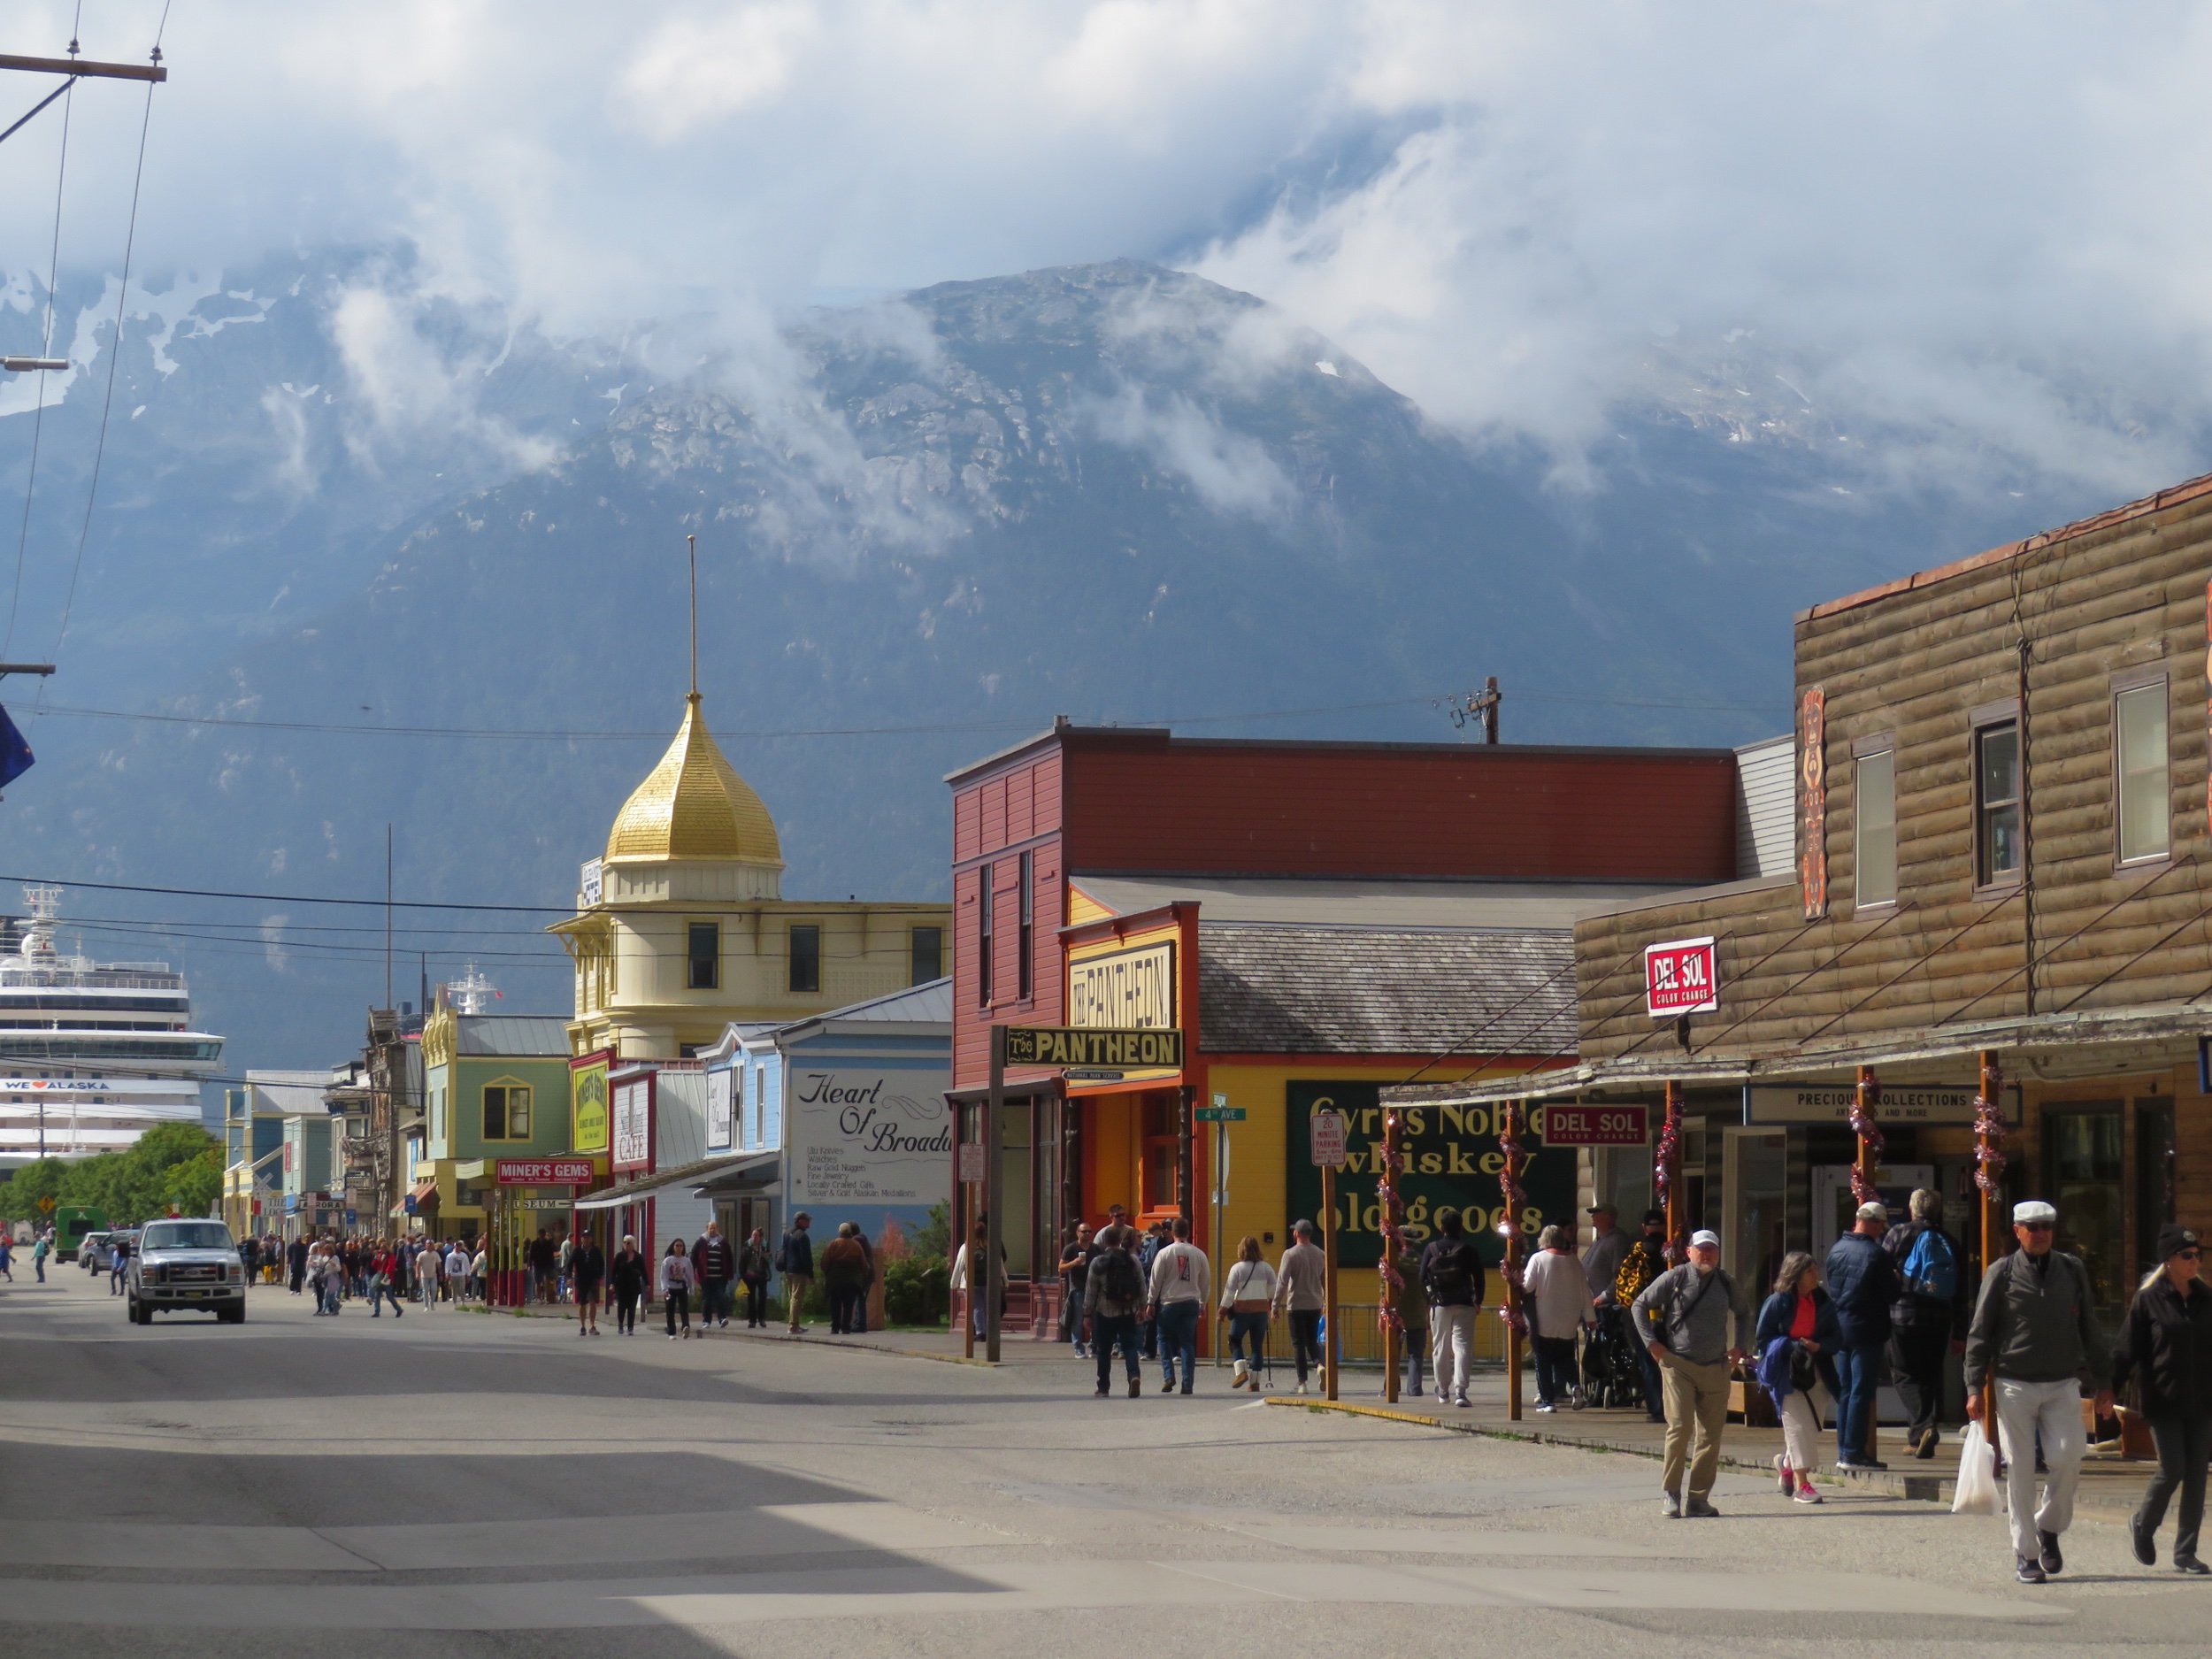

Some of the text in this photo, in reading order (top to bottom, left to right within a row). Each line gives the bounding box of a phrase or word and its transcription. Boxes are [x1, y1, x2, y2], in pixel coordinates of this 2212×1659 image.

[1655, 954, 1707, 991] DEL SOL
[1073, 982, 1086, 1025] THE
[1657, 989, 1708, 1004] COLOR CHANGE
[1010, 1032, 1174, 1063] The PANTHEON
[798, 1074, 884, 1103] Heart
[1798, 1094, 1854, 1105] PRECIOU
[840, 1105, 877, 1134] Of
[1221, 1109, 1237, 1119] AVE
[1553, 1113, 1639, 1132] DEL SOL
[864, 1122, 952, 1152] Broadw
[501, 1164, 589, 1177] MINER'S GEMS
[841, 1164, 865, 1173] Nuggets
